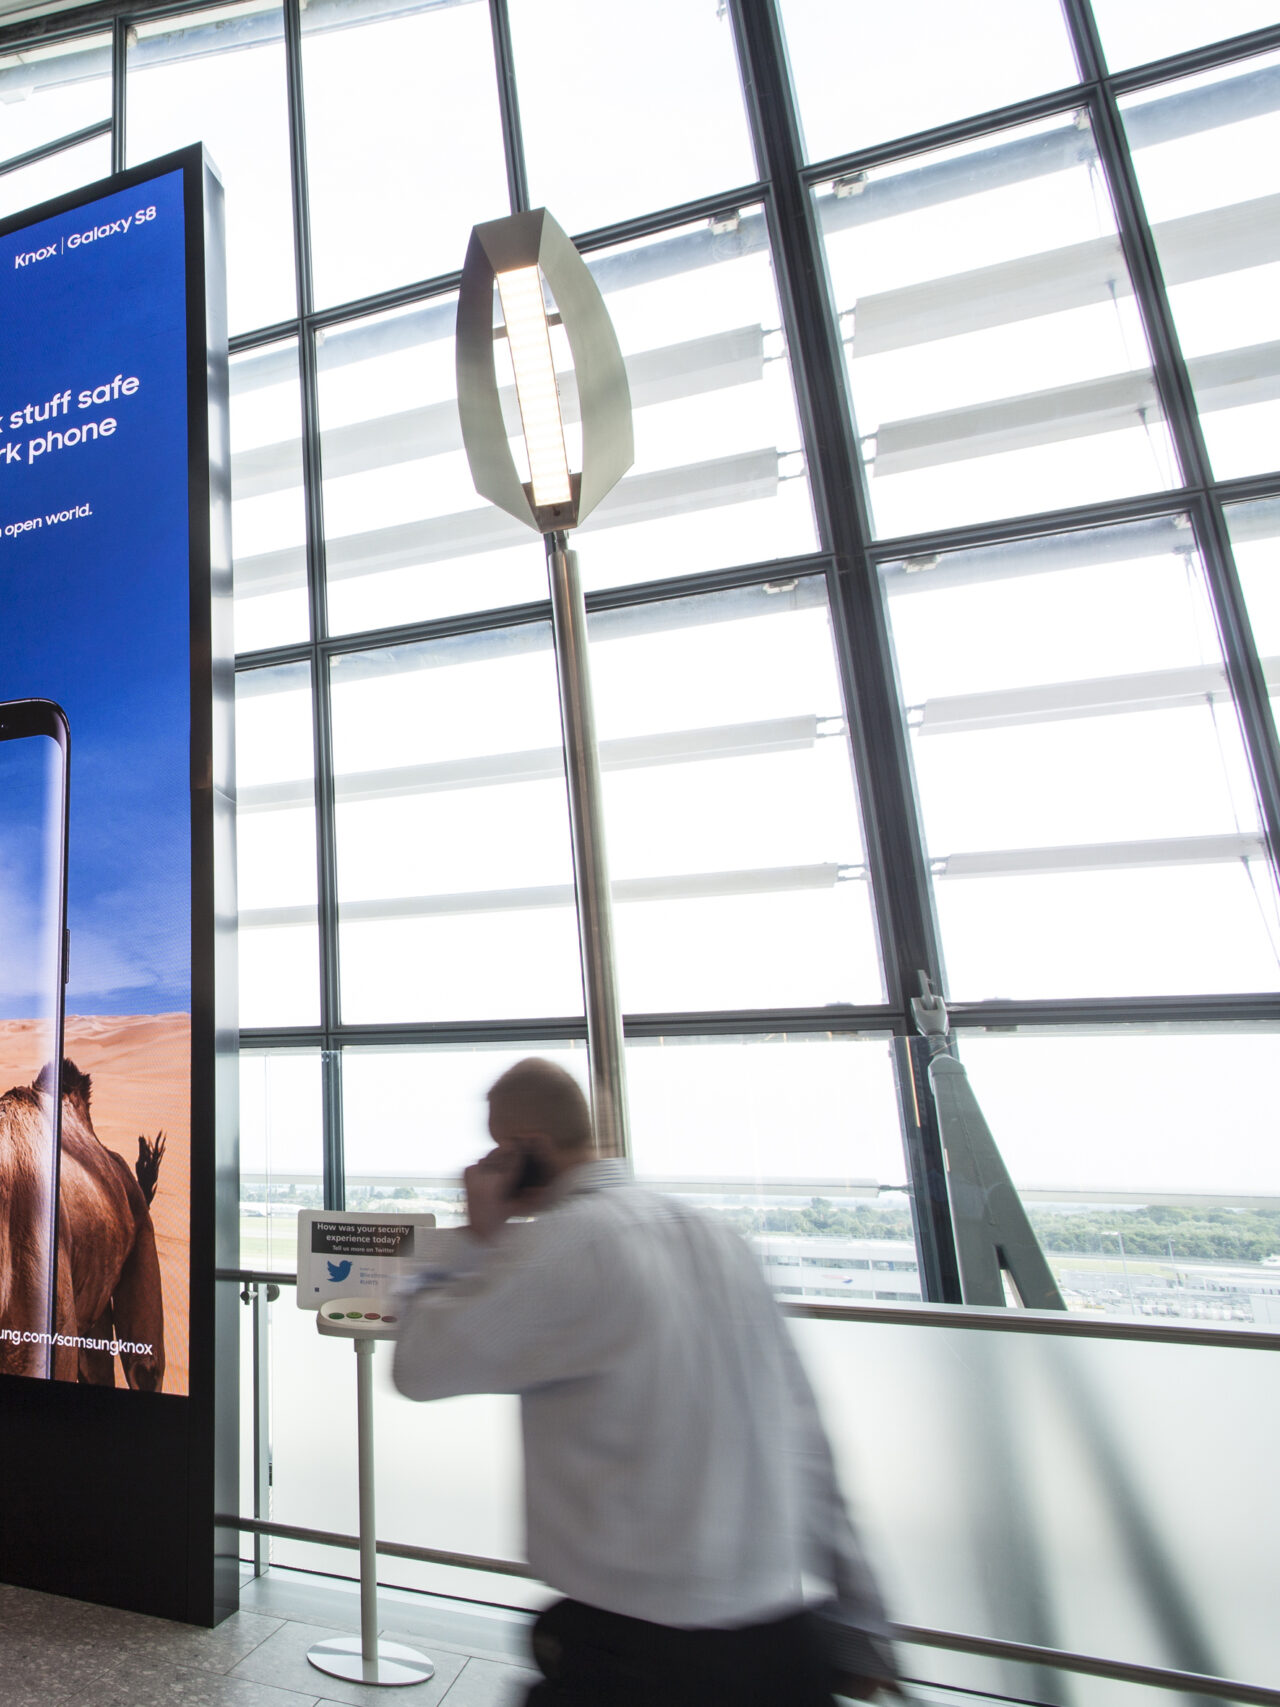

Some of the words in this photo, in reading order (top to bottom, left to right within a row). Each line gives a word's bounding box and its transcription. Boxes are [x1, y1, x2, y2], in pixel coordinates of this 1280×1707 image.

[14, 243, 57, 269] Knox
[67, 212, 133, 249] Galaxy
[135, 206, 157, 225] S8
[9, 390, 73, 430] stuff
[77, 374, 140, 409] safe
[28, 417, 118, 464] phone
[4, 516, 43, 537] open
[45, 503, 93, 527] world.
[317, 1223, 336, 1231] How
[357, 1226, 376, 1235] your
[378, 1225, 410, 1235] security
[326, 1234, 371, 1243] experience
[372, 1236, 401, 1245] today?
